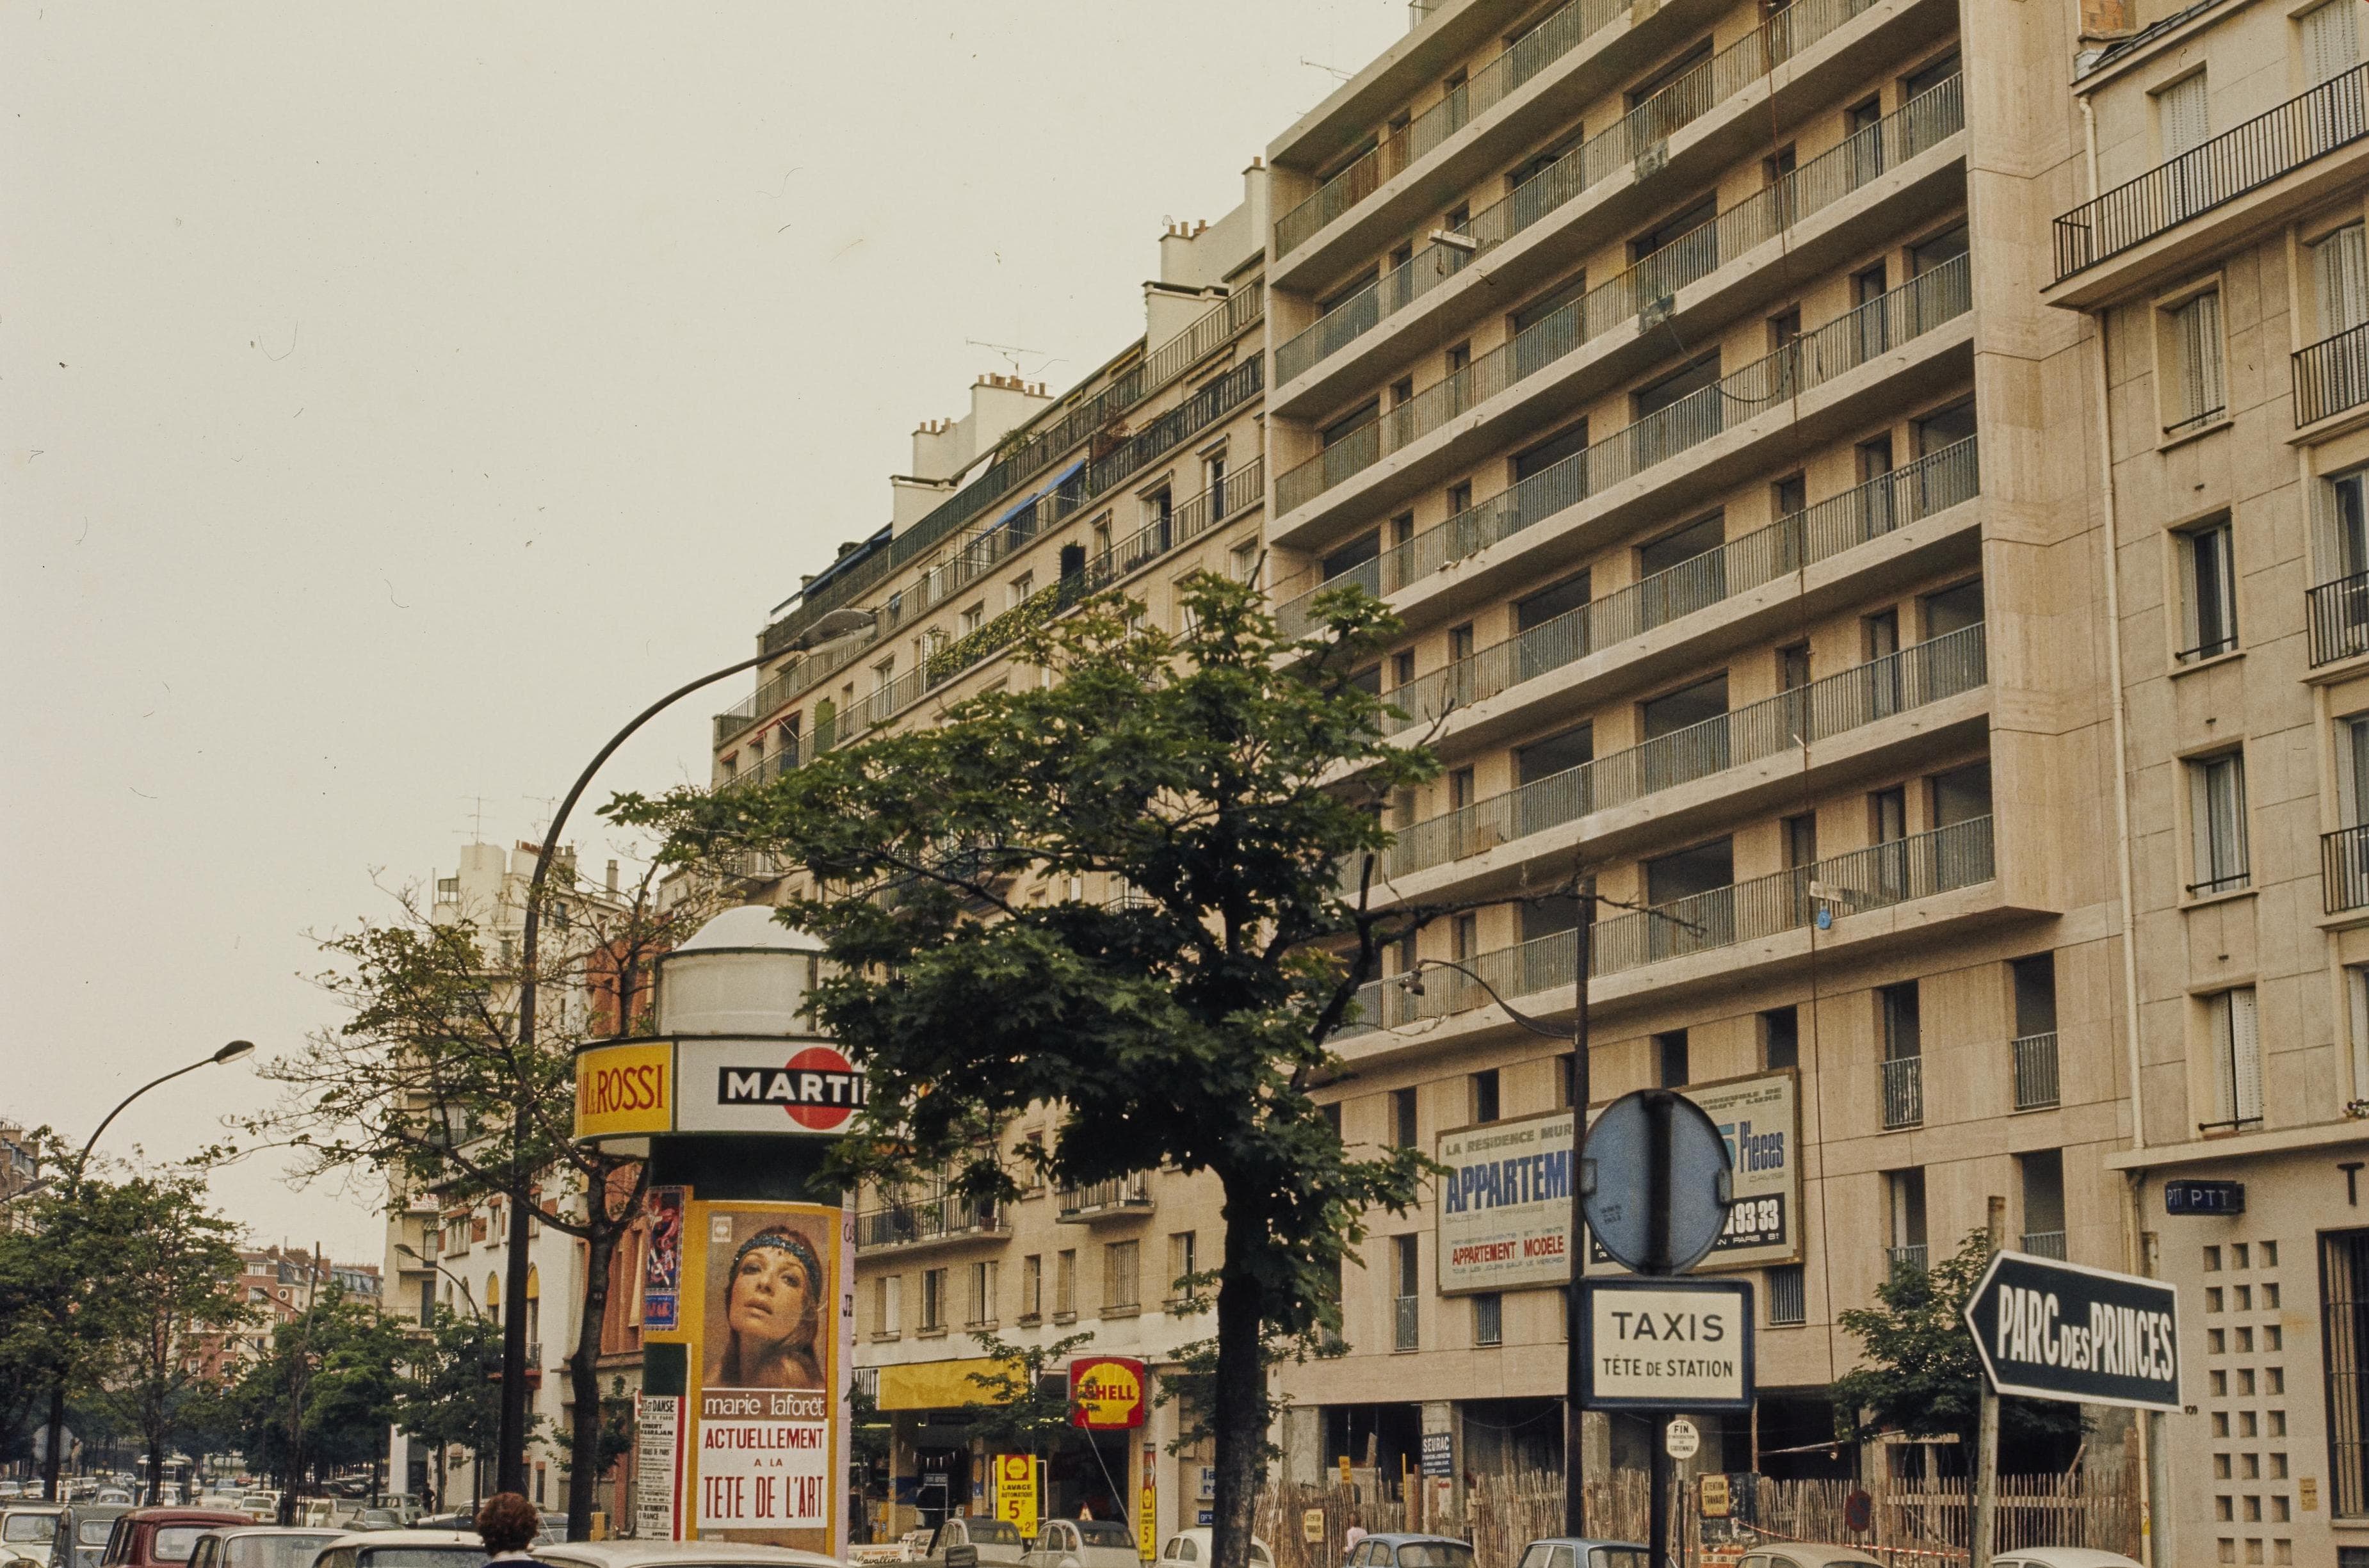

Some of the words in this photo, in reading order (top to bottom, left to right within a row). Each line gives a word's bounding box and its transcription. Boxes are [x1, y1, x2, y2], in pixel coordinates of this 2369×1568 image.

[597, 1064, 664, 1114] ROSSI
[1446, 1143, 1462, 1156] LA
[1467, 1129, 1535, 1152] RESIDENCE
[1540, 1122, 1574, 1140] MUR
[2167, 1188, 2182, 1207] PTT
[2190, 1189, 2230, 1206] PTT
[1735, 1202, 1756, 1234] 93
[1758, 1199, 1779, 1231] 33
[1452, 1241, 1516, 1266] APPARTEMENT
[1524, 1234, 1564, 1257] MODELE
[1611, 1311, 1724, 1342] TAXIS
[1997, 1283, 2060, 1366] PARC
[2060, 1323, 2090, 1371] DES
[2090, 1301, 2174, 1382] PRINCES
[1603, 1353, 1642, 1377] TÊTE
[1646, 1362, 1662, 1377] DE
[1666, 1359, 1733, 1378] STATION
[652, 1400, 674, 1412] DANSE
[704, 1393, 761, 1415] marie
[770, 1394, 827, 1417] laforêt
[704, 1428, 824, 1450] ACTUELLEMENT
[1674, 1425, 1689, 1434] FIN
[754, 1458, 762, 1467] A
[770, 1458, 783, 1467] LA
[704, 1476, 745, 1519] TETE
[755, 1476, 776, 1519] DE
[786, 1476, 824, 1518] L'ART
[1008, 1499, 1020, 1519] 5
[1024, 1521, 1031, 1532] 2
[1144, 1526, 1149, 1544] 5
